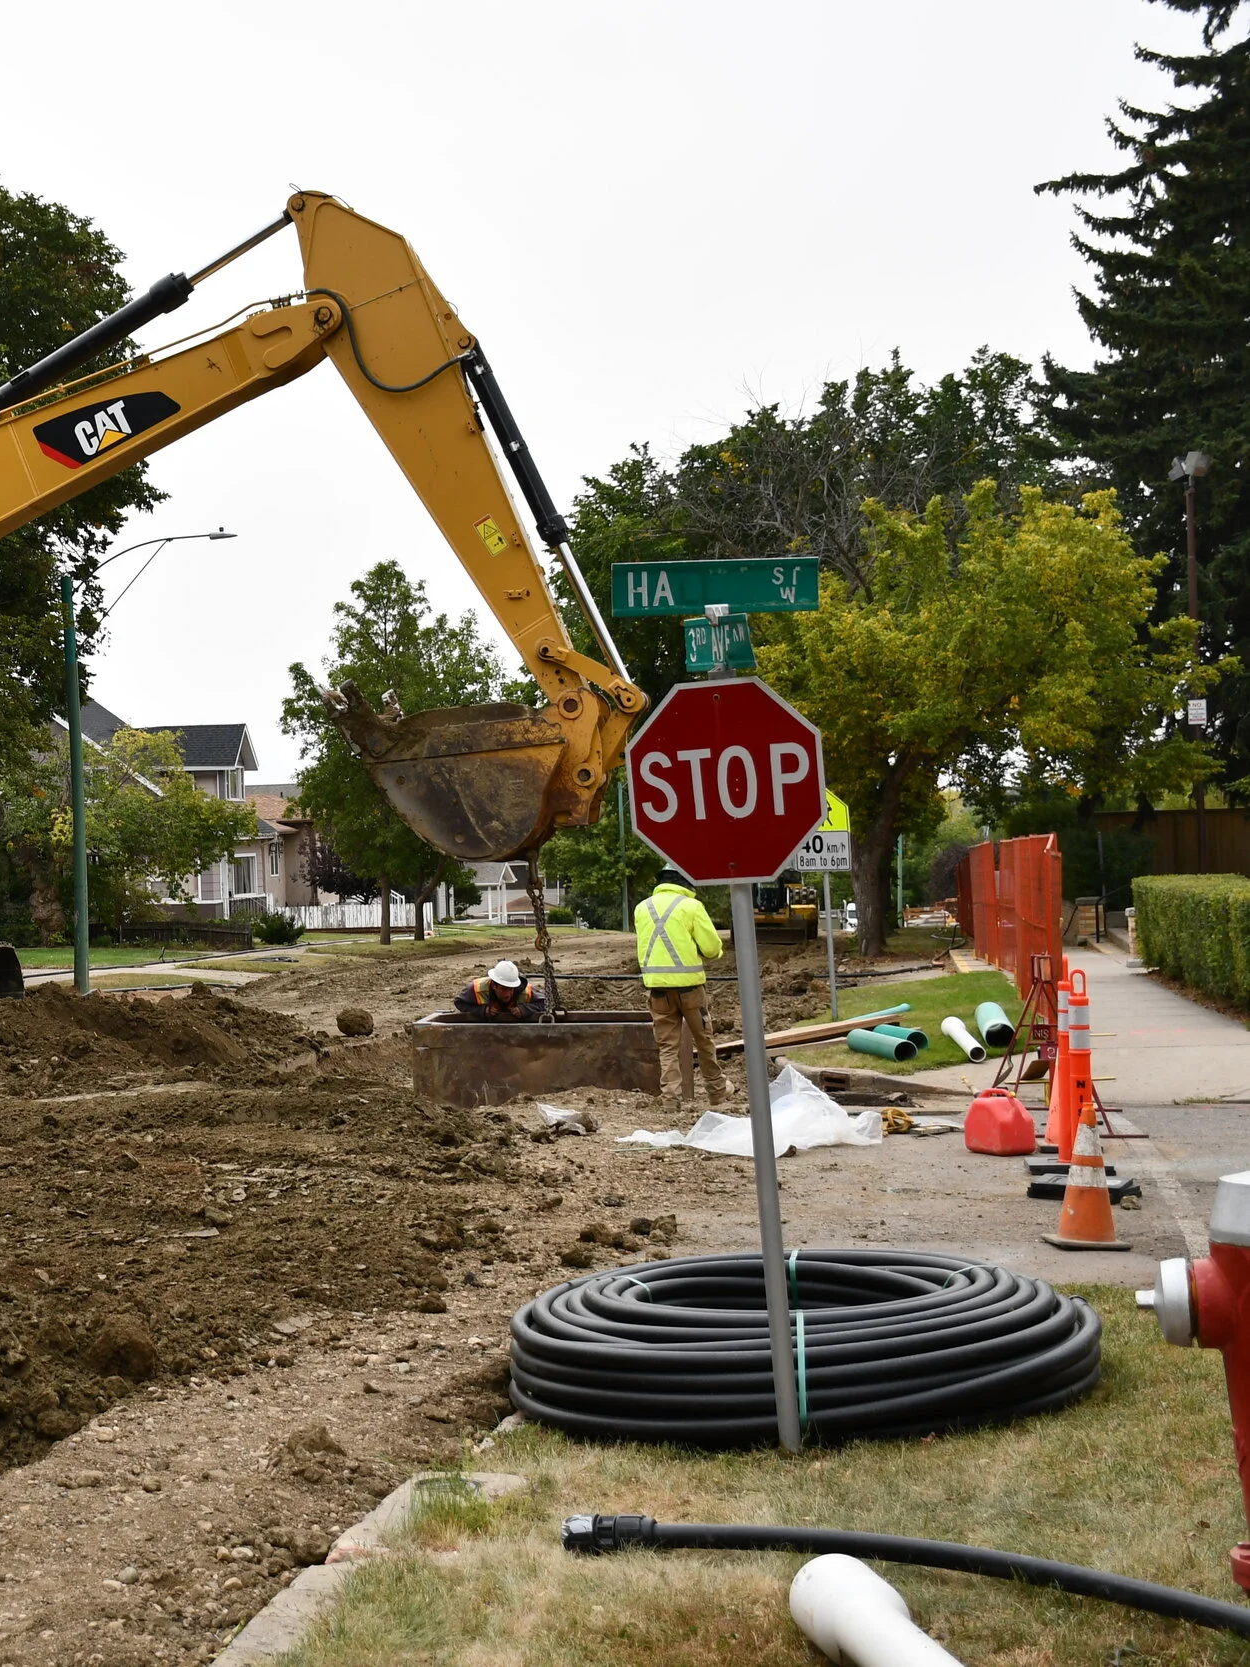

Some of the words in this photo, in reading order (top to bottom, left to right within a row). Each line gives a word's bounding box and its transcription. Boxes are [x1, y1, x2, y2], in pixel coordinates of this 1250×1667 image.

[74, 400, 132, 456] CAT
[639, 742, 810, 823] STOP
[799, 856, 817, 867] 8am
[820, 856, 828, 867] to
[830, 856, 848, 868] 6pm
[826, 842, 846, 853] km/h
